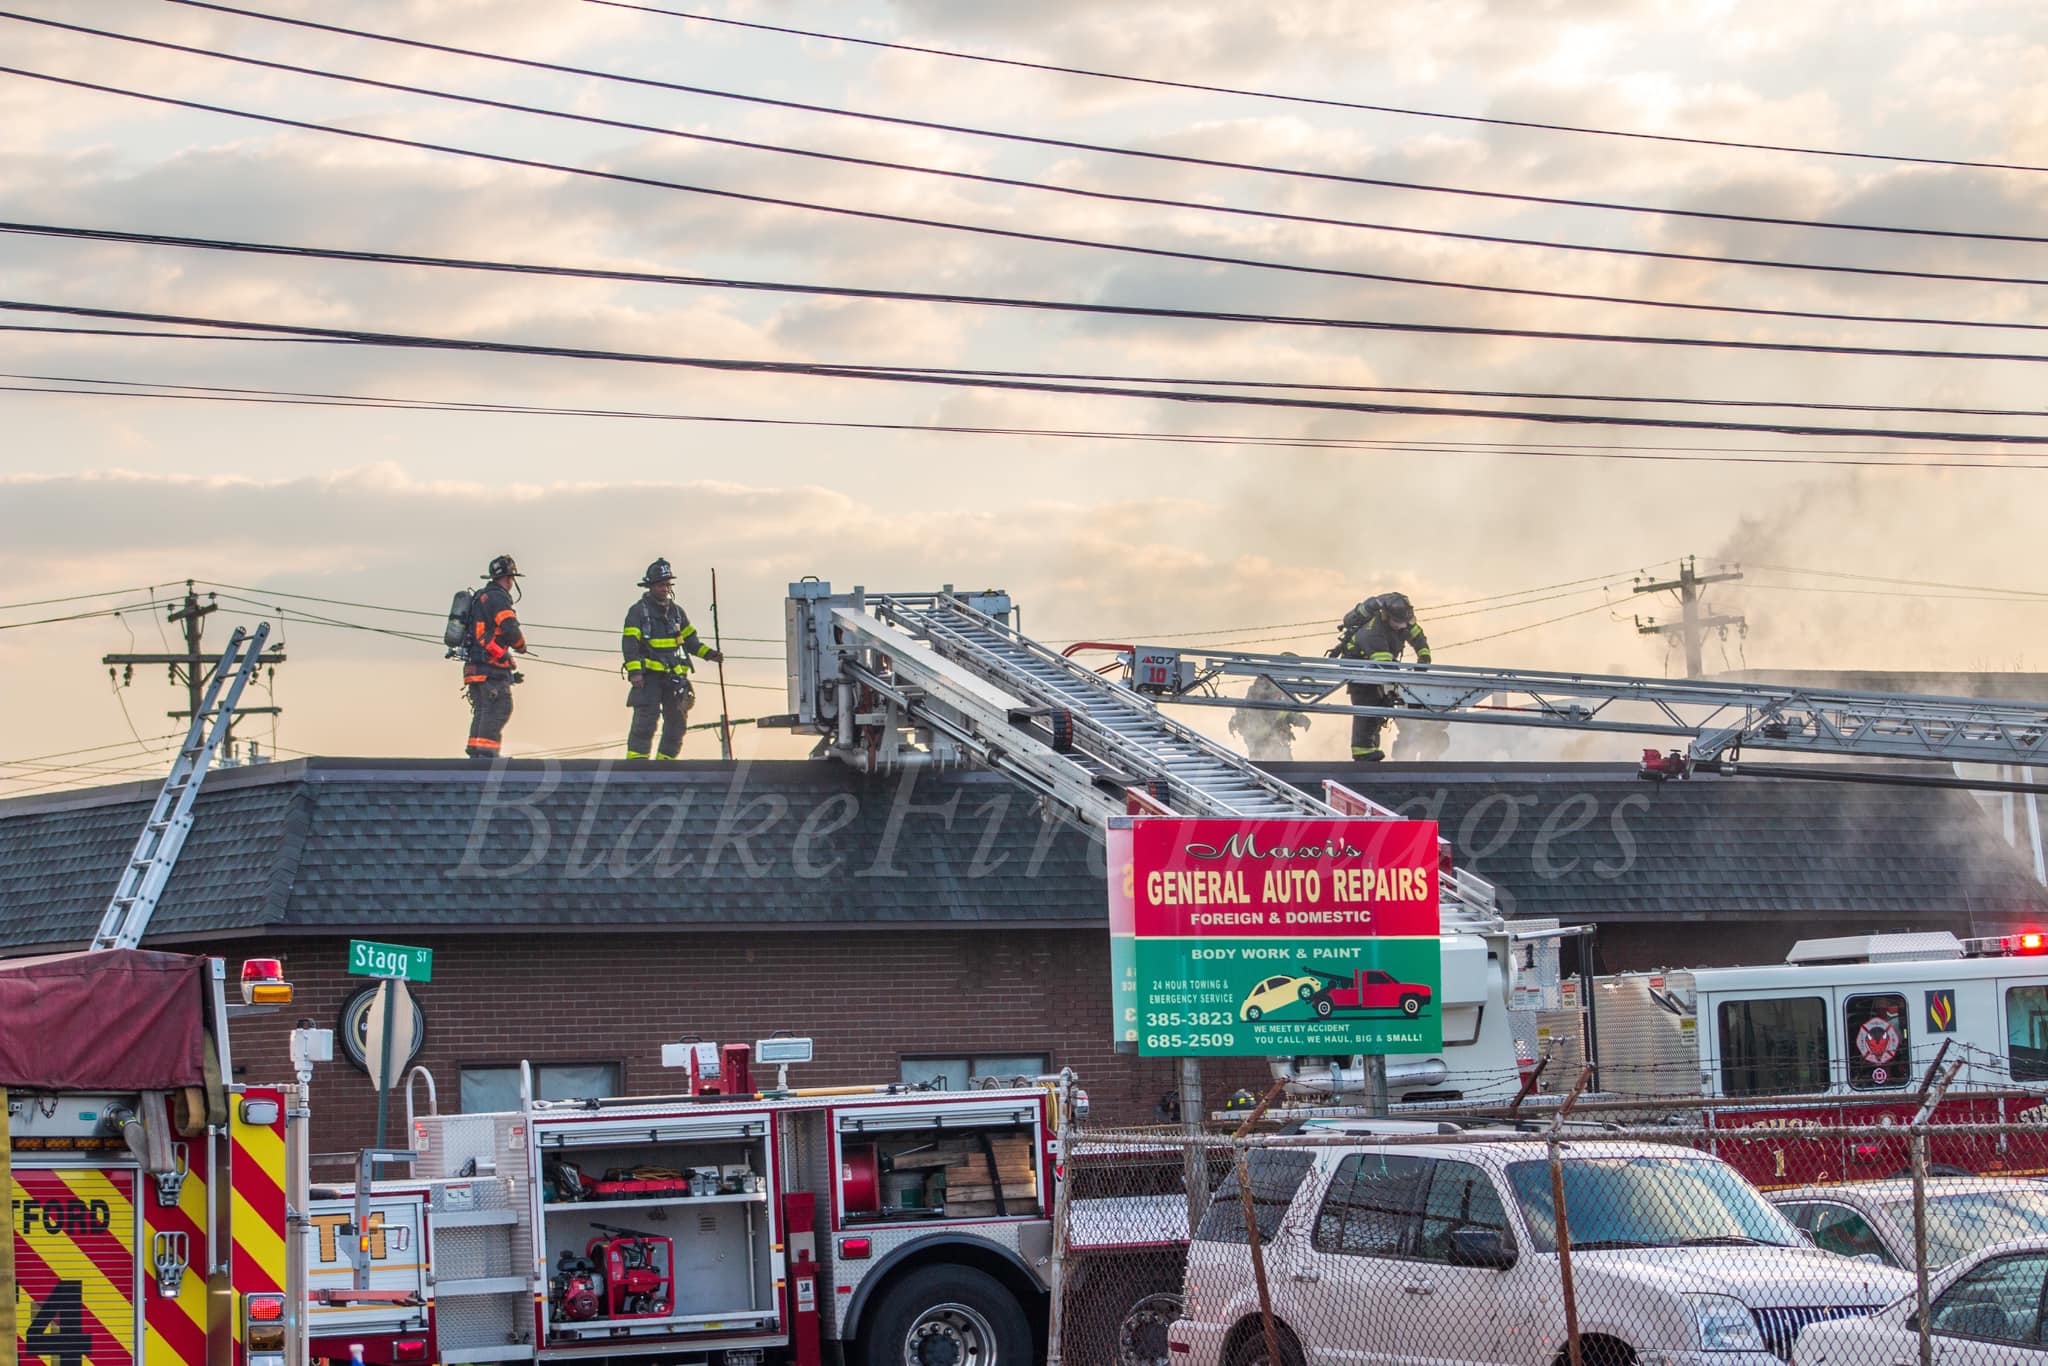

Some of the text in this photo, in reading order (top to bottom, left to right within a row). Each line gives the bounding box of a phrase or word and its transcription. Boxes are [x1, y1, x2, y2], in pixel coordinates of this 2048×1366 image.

[1148, 667, 1167, 683] 10
[1184, 832, 1362, 860] Maxi's
[1147, 870, 1251, 906] GENERAL
[1262, 868, 1321, 904] AUTO
[1333, 867, 1428, 903] REPAIRS
[1190, 910, 1371, 926] FOREIGN & DOMESTIC
[355, 944, 408, 977] Stagg
[1191, 947, 1362, 960] BODY WORK & PAINT
[1152, 979, 1229, 991] 24 HOUR TOWING &
[1149, 993, 1234, 1005] EMERGENCY SERVICE
[1146, 1011, 1233, 1028] 385-3823
[1253, 1023, 1350, 1034] WE MEET BY ACCIDENT
[1147, 1033, 1234, 1048] 685-2509
[1254, 1036, 1274, 1045] YOU
[1307, 1035, 1321, 1044] WE
[1355, 1034, 1373, 1043] BIG
[1376, 1034, 1383, 1042] &
[1386, 1033, 1423, 1043] SMALL!
